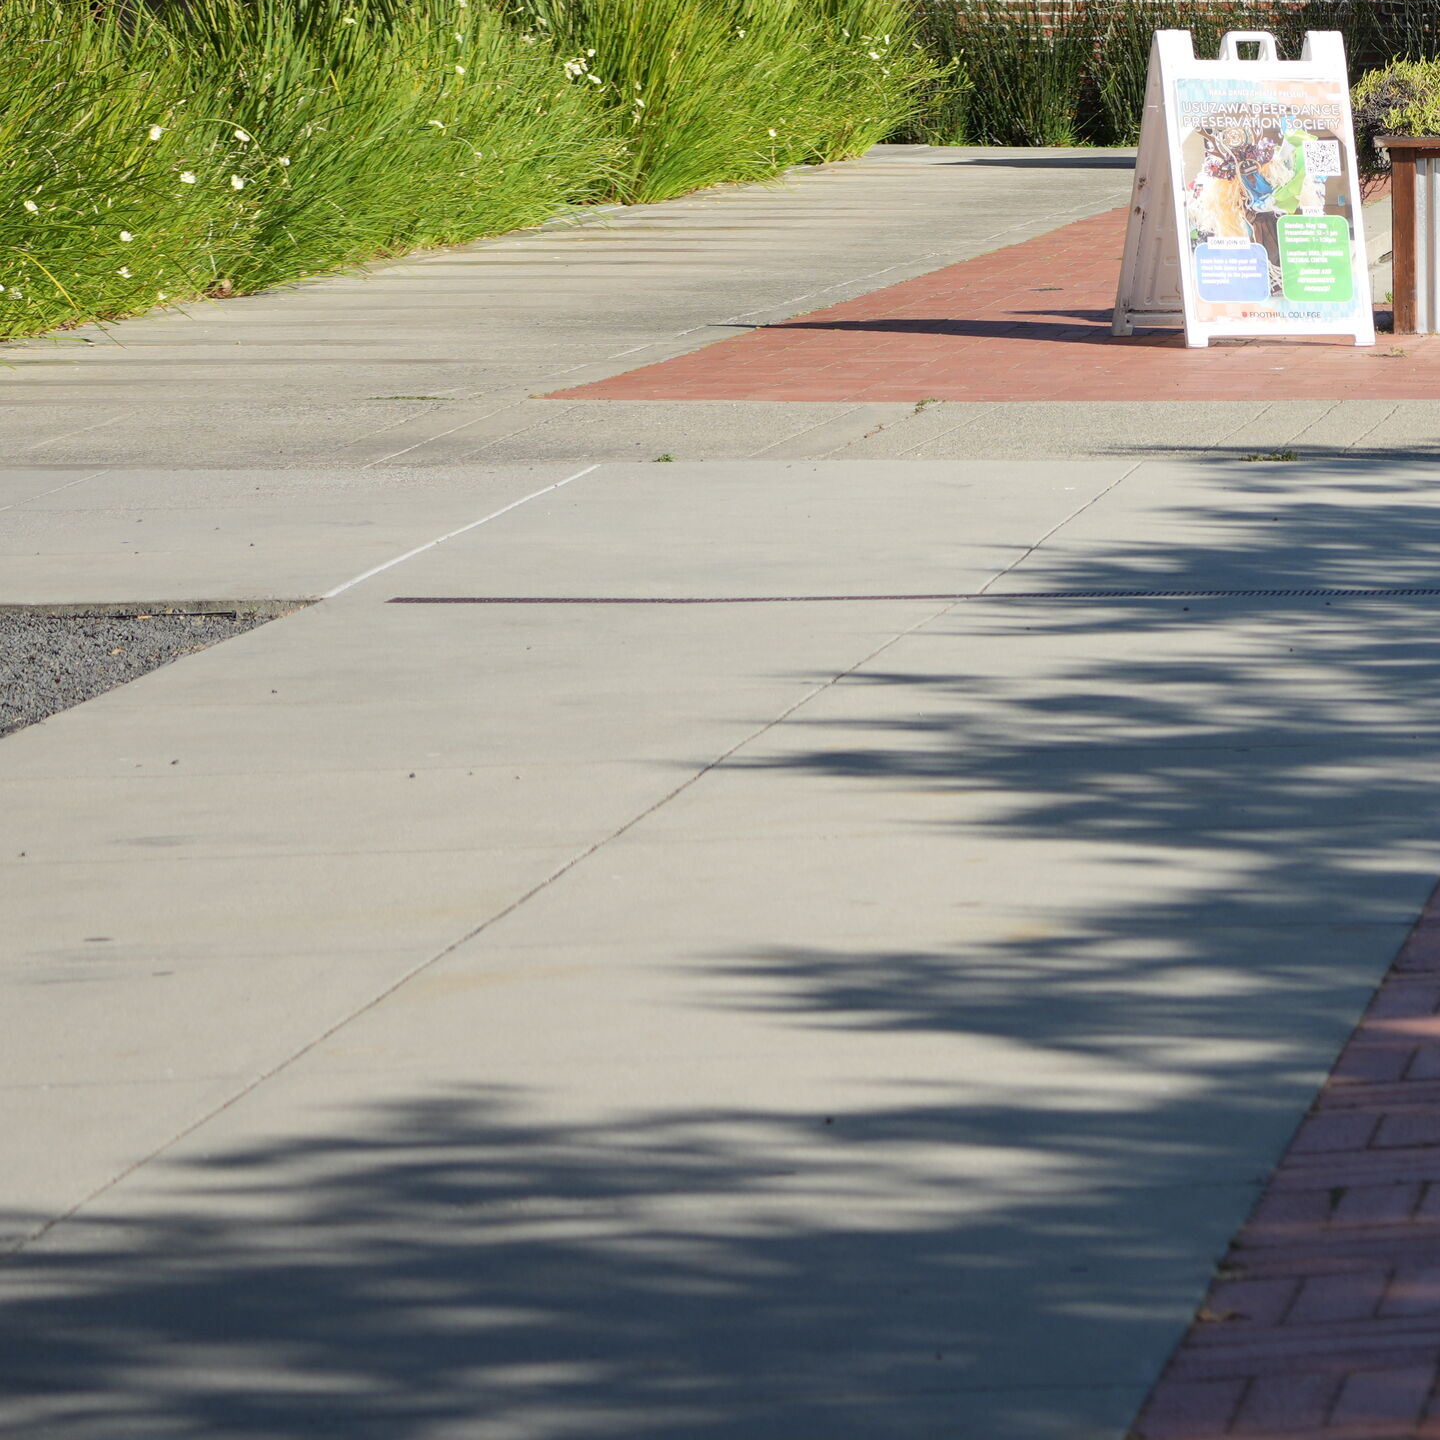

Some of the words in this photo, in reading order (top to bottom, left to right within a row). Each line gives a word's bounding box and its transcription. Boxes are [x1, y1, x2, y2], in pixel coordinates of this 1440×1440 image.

[1182, 102, 1248, 114] USUZAWA
[1252, 102, 1287, 115] DEER
[1291, 104, 1340, 116] DANCE
[1183, 116, 1282, 128] PRESERVATION
[1285, 117, 1340, 130] SOCIETY
